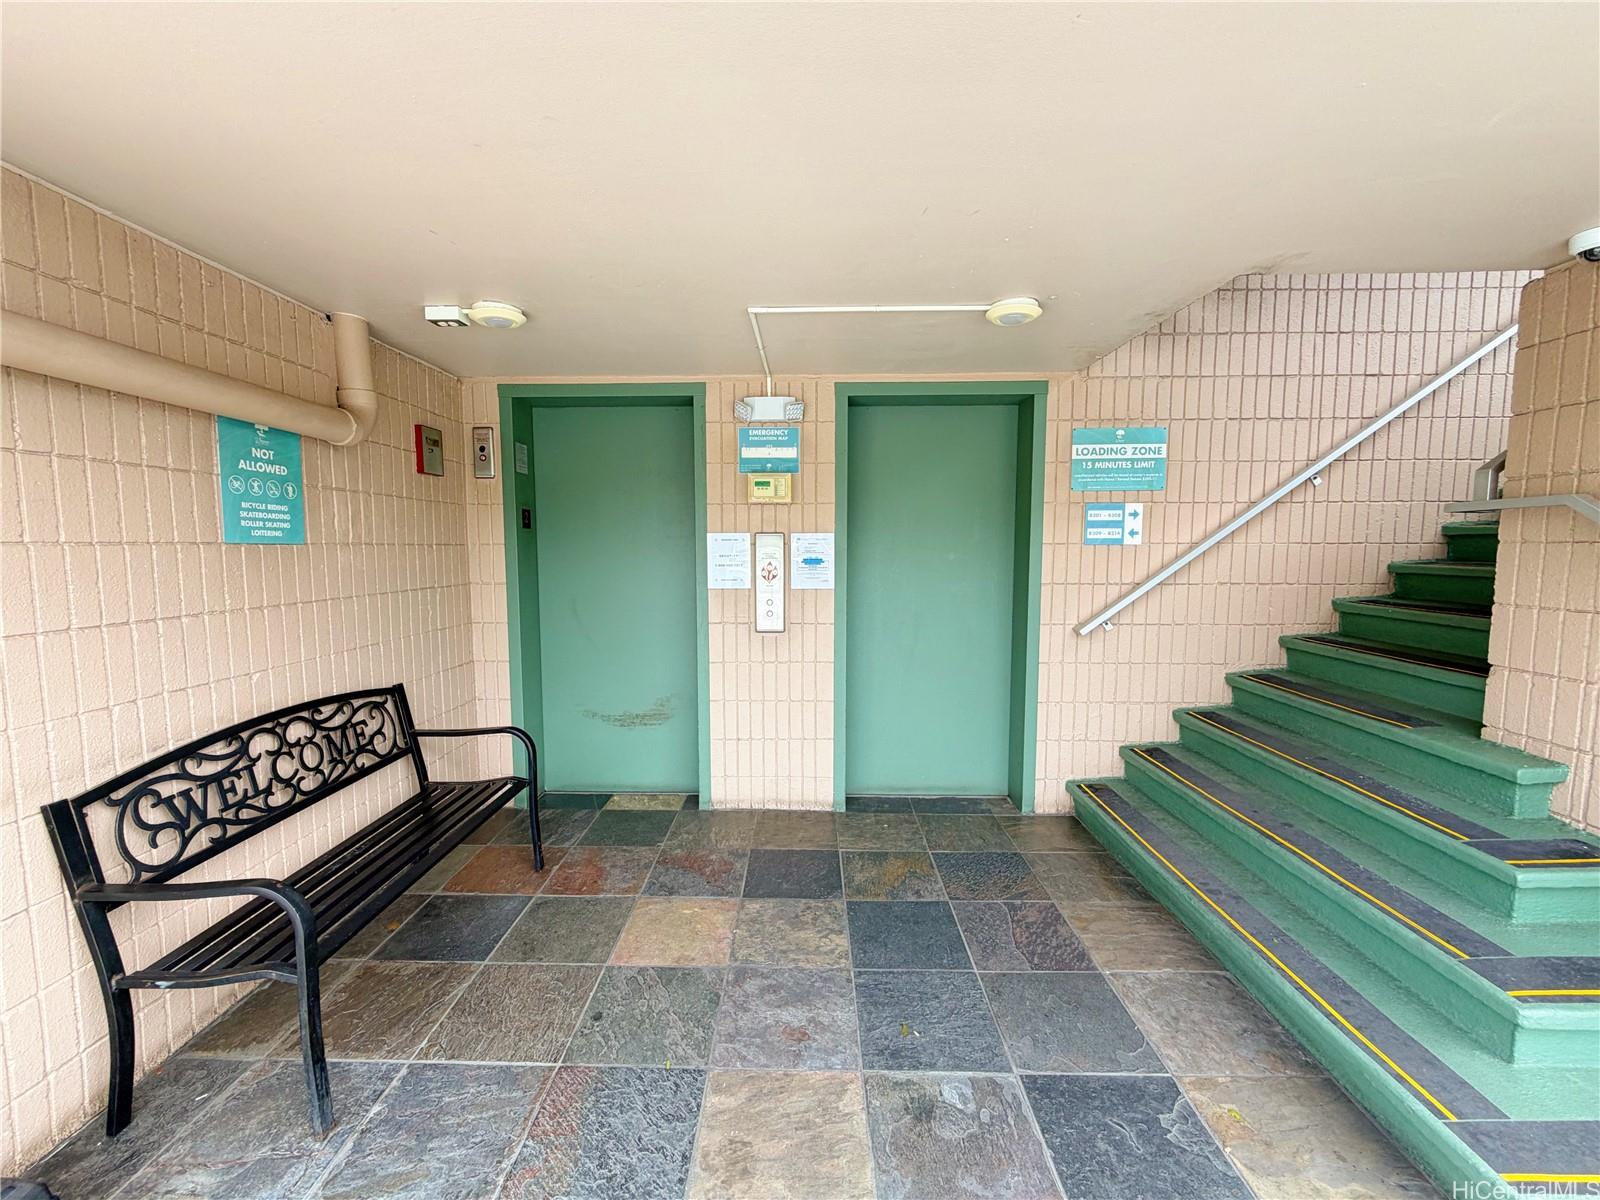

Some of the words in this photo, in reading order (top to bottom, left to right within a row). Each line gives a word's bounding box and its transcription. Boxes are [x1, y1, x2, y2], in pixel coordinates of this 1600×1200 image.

[251, 447, 274, 460] NOT
[1075, 447, 1127, 456] LOADING
[1131, 446, 1163, 456] ZONE
[238, 459, 288, 476] ALLOWED
[1094, 461, 1131, 469] MINUTES
[241, 501, 266, 510] BICYCLE
[267, 503, 289, 512] RIDING
[239, 511, 291, 520] SKATEBOARDING
[240, 520, 264, 528] ROLLER
[265, 521, 291, 529] SKATING
[251, 529, 283, 537] LOITERING
[161, 719, 368, 829] WELCOME
